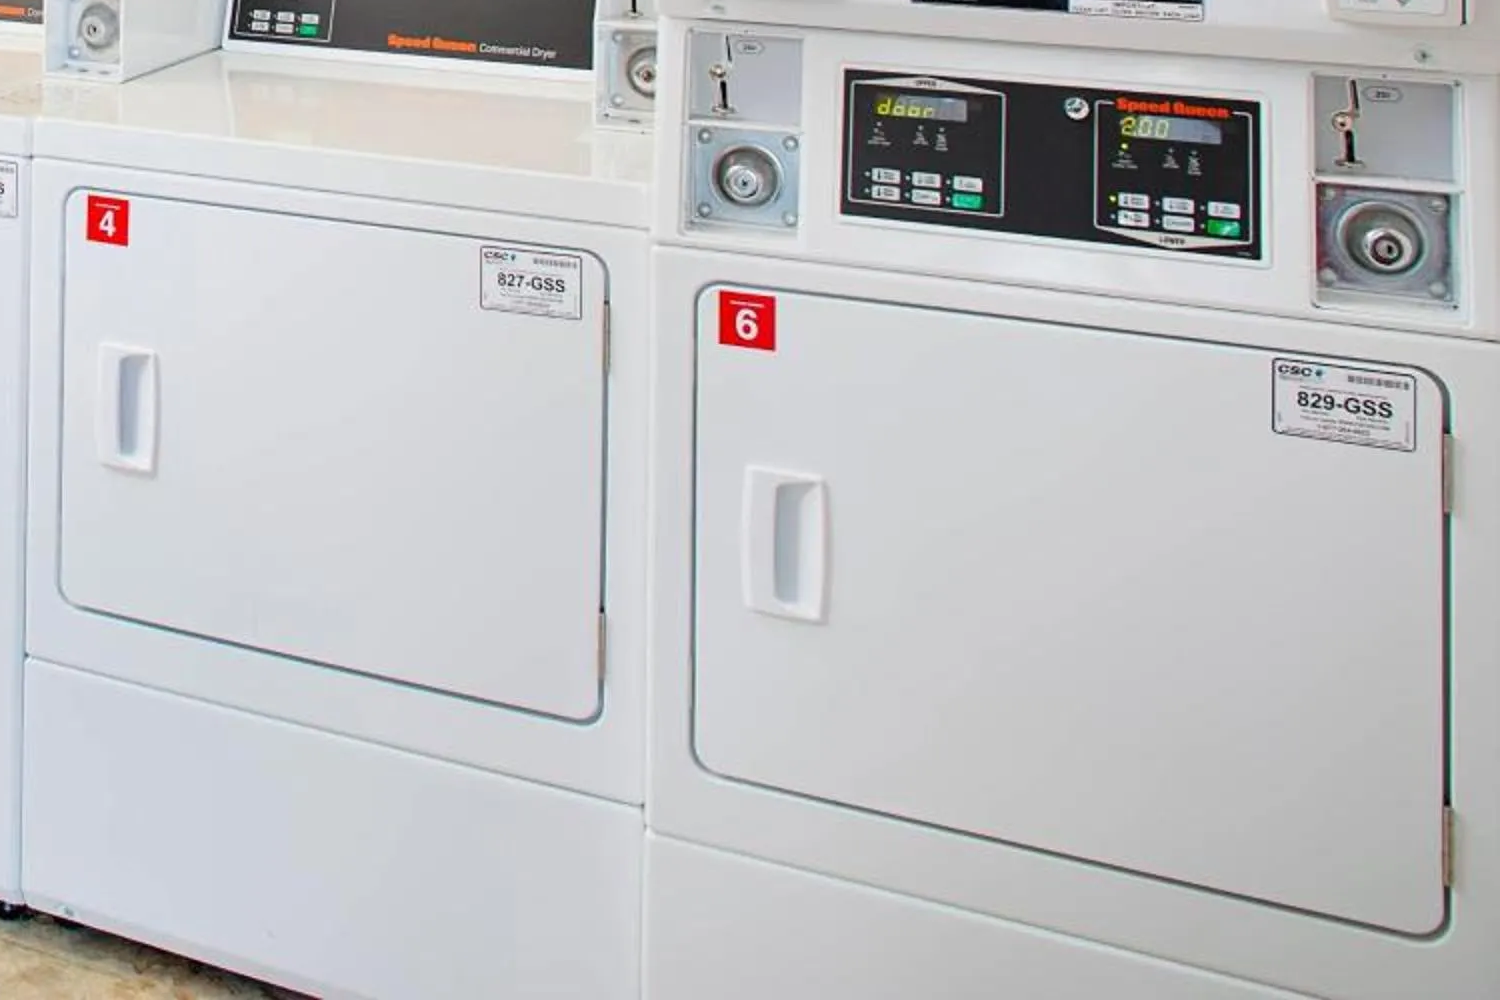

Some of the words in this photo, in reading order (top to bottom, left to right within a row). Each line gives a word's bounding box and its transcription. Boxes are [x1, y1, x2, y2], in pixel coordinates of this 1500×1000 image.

[387, 32, 432, 49] Speed
[479, 42, 531, 58] Commercial
[531, 46, 558, 61] Dryer
[1115, 96, 1171, 114] Speed
[1172, 101, 1231, 119] Queen
[99, 210, 117, 238] 4
[497, 271, 566, 293] 827-GSS
[735, 307, 759, 341] 6
[1277, 364, 1313, 378] CSC
[1296, 390, 1394, 419] 829-GSS
